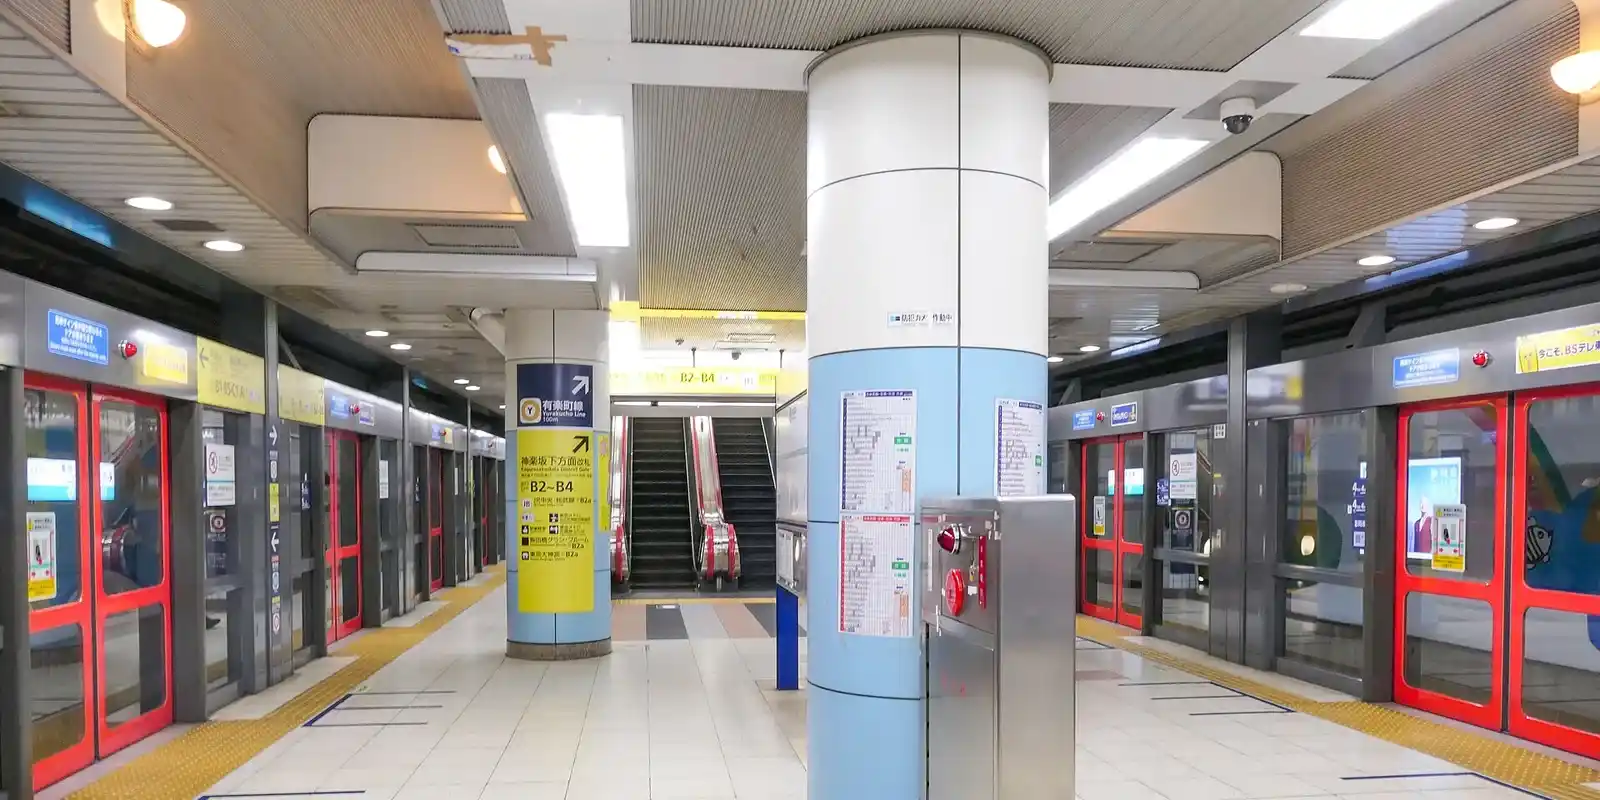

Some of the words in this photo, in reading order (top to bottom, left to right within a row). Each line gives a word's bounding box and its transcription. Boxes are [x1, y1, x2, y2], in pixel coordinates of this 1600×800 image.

[901, 313, 953, 322] 防犯カメ作動中
[542, 400, 584, 411] 有楽町線
